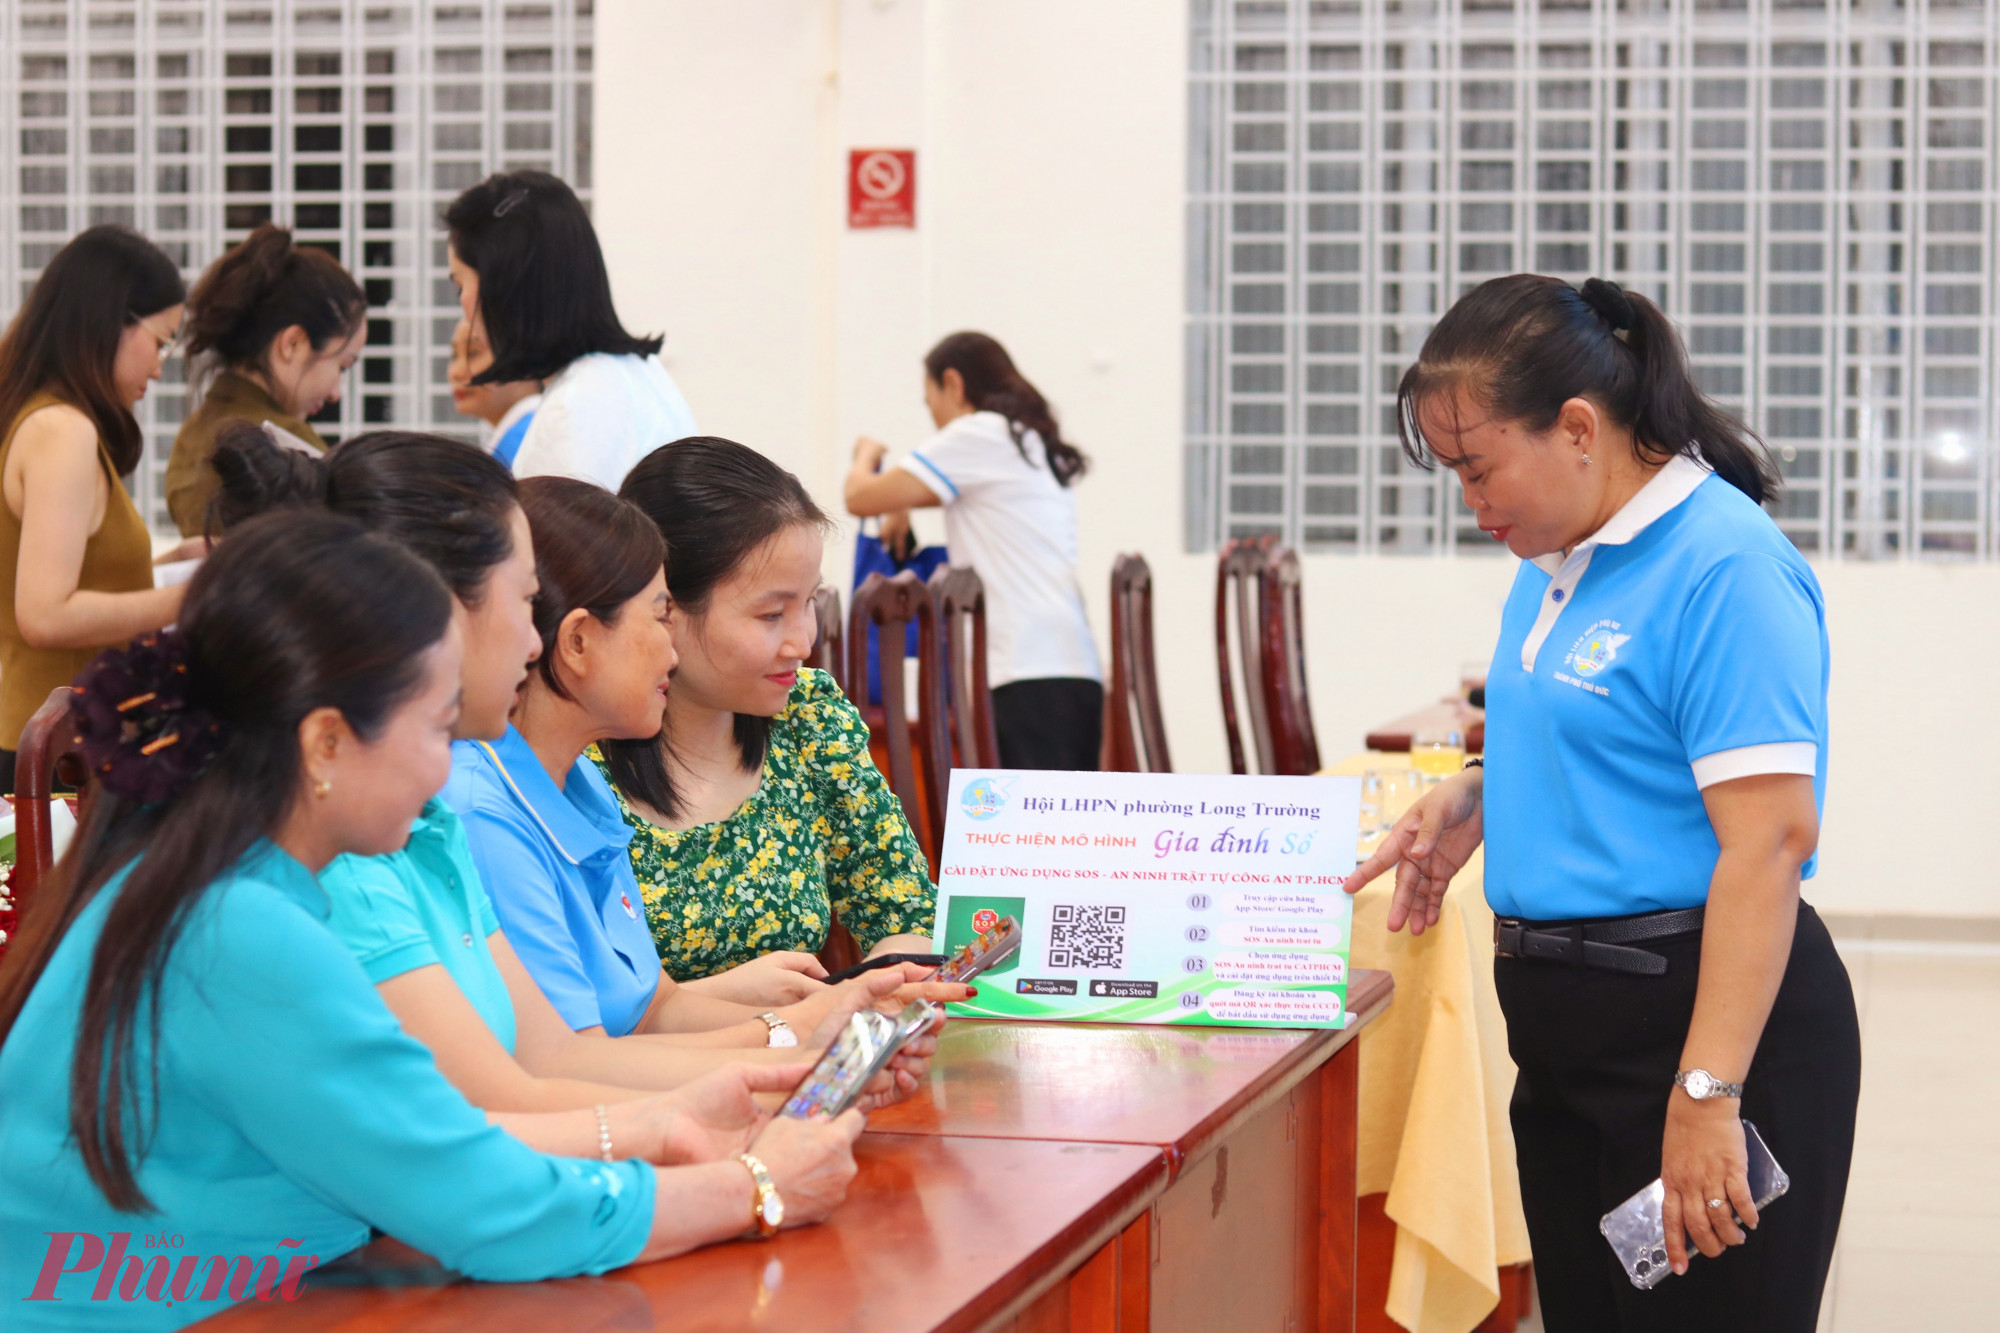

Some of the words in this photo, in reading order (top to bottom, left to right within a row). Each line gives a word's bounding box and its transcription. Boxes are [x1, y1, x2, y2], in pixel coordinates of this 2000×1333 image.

[1023, 797, 1054, 814] Hội
[1061, 798, 1118, 813] LHPN
[1123, 799, 1194, 818] phường
[1200, 802, 1246, 819] Long
[1252, 800, 1320, 820] Trường
[966, 832, 1011, 847] THỰC
[1016, 832, 1055, 848] HIỆN
[1061, 832, 1088, 847] MÔ
[1094, 835, 1136, 848] HÌNH
[1154, 829, 1200, 859] Gia
[1210, 826, 1270, 854] đình
[1280, 829, 1319, 855] Số
[944, 865, 966, 877] CÀI
[969, 865, 997, 878] ĐẶT
[999, 865, 1029, 878] ỨNG
[1032, 868, 1071, 880] DỤNG
[1074, 869, 1099, 879] SOS
[1110, 870, 1129, 880] AN
[1132, 871, 1167, 881] NINH
[1171, 870, 1206, 884] TRẬT
[1209, 871, 1229, 884] TỰ
[1232, 871, 1270, 884] CÔNG
[1273, 874, 1292, 884] AN
[1191, 896, 1206, 909] 01
[1244, 894, 1261, 902] Truy
[1234, 905, 1250, 913] App
[1278, 906, 1305, 914] Google
[1307, 906, 1324, 914] Play
[1189, 928, 1206, 942] 02
[1248, 951, 1269, 959] Chọn
[1272, 952, 1286, 960] ứng
[1289, 952, 1308, 960] dụng
[1186, 959, 1203, 972] 03
[1272, 973, 1292, 981] dụng
[1034, 985, 1059, 993] Google
[1060, 986, 1074, 994] Play
[1110, 987, 1125, 996] App
[1125, 988, 1152, 996] Store
[1182, 994, 1199, 1007] 04
[1271, 1012, 1291, 1021] dụng
[1293, 1012, 1308, 1021] ứng
[1310, 1013, 1330, 1021] dụng
